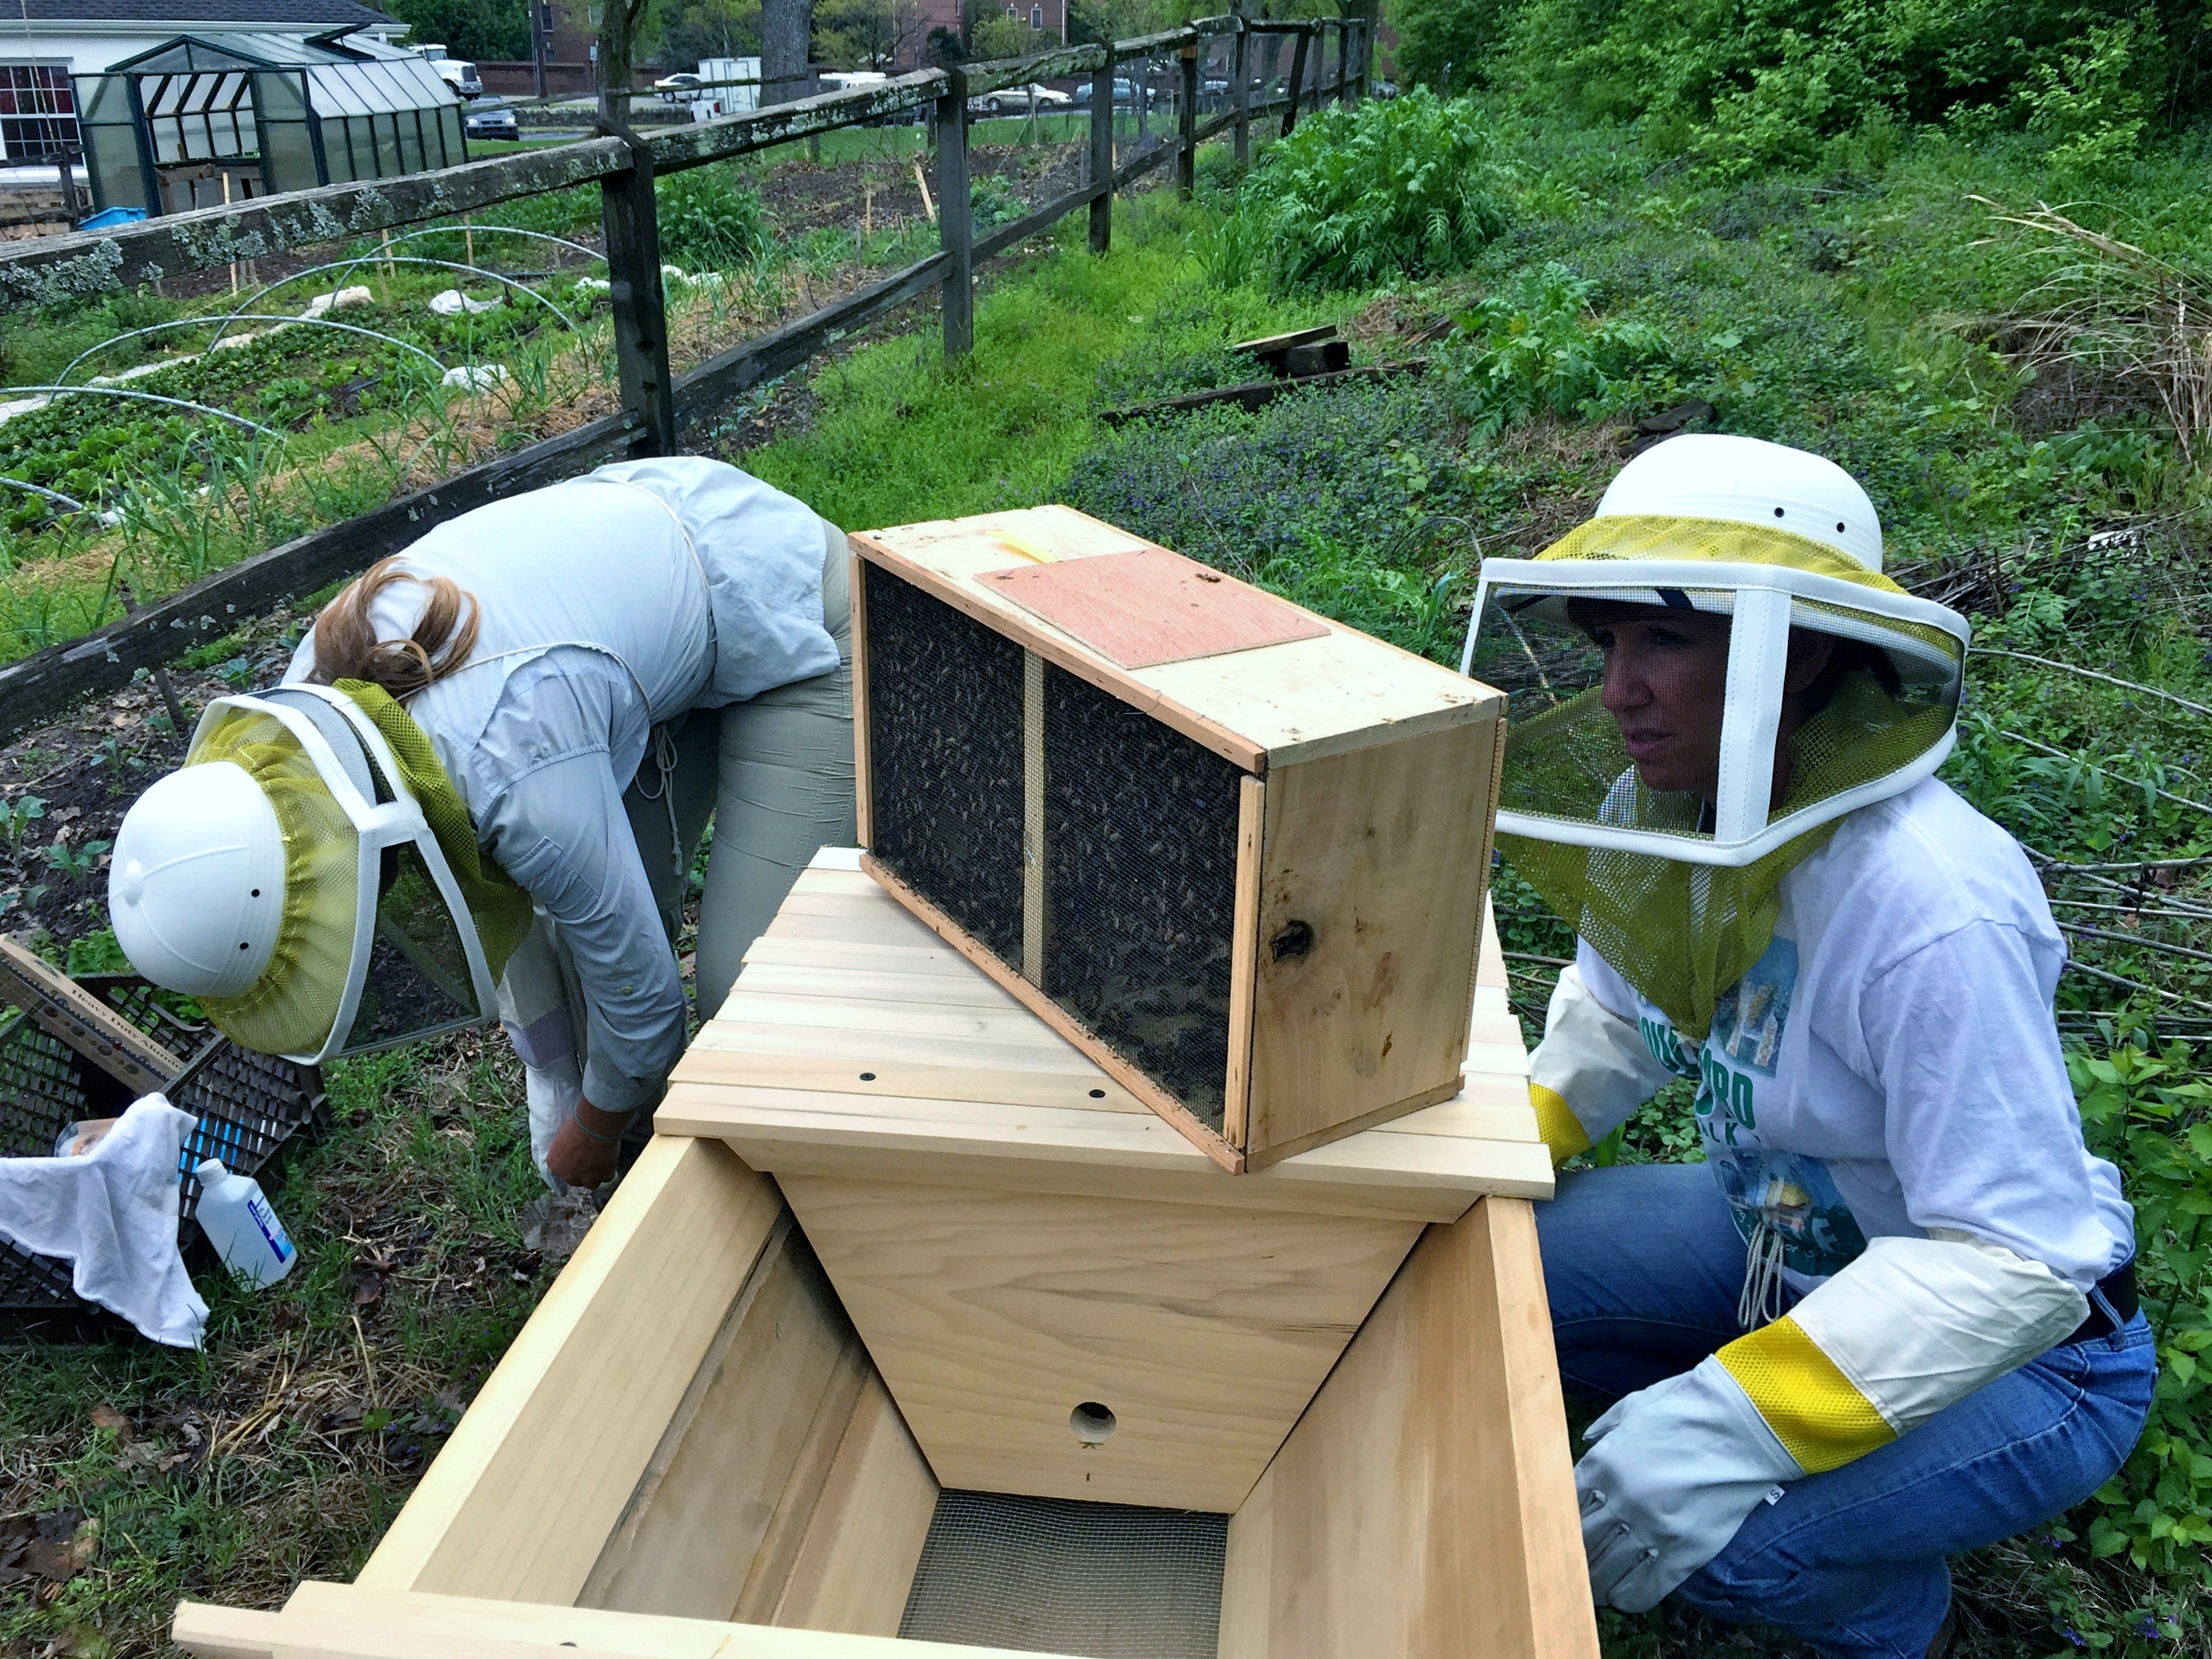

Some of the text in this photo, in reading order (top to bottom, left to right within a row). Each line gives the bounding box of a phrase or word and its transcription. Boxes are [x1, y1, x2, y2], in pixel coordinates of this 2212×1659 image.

[73, 989, 107, 1017] Heavy
[111, 1017, 139, 1039] Duty
[1770, 1489, 1780, 1500] S
